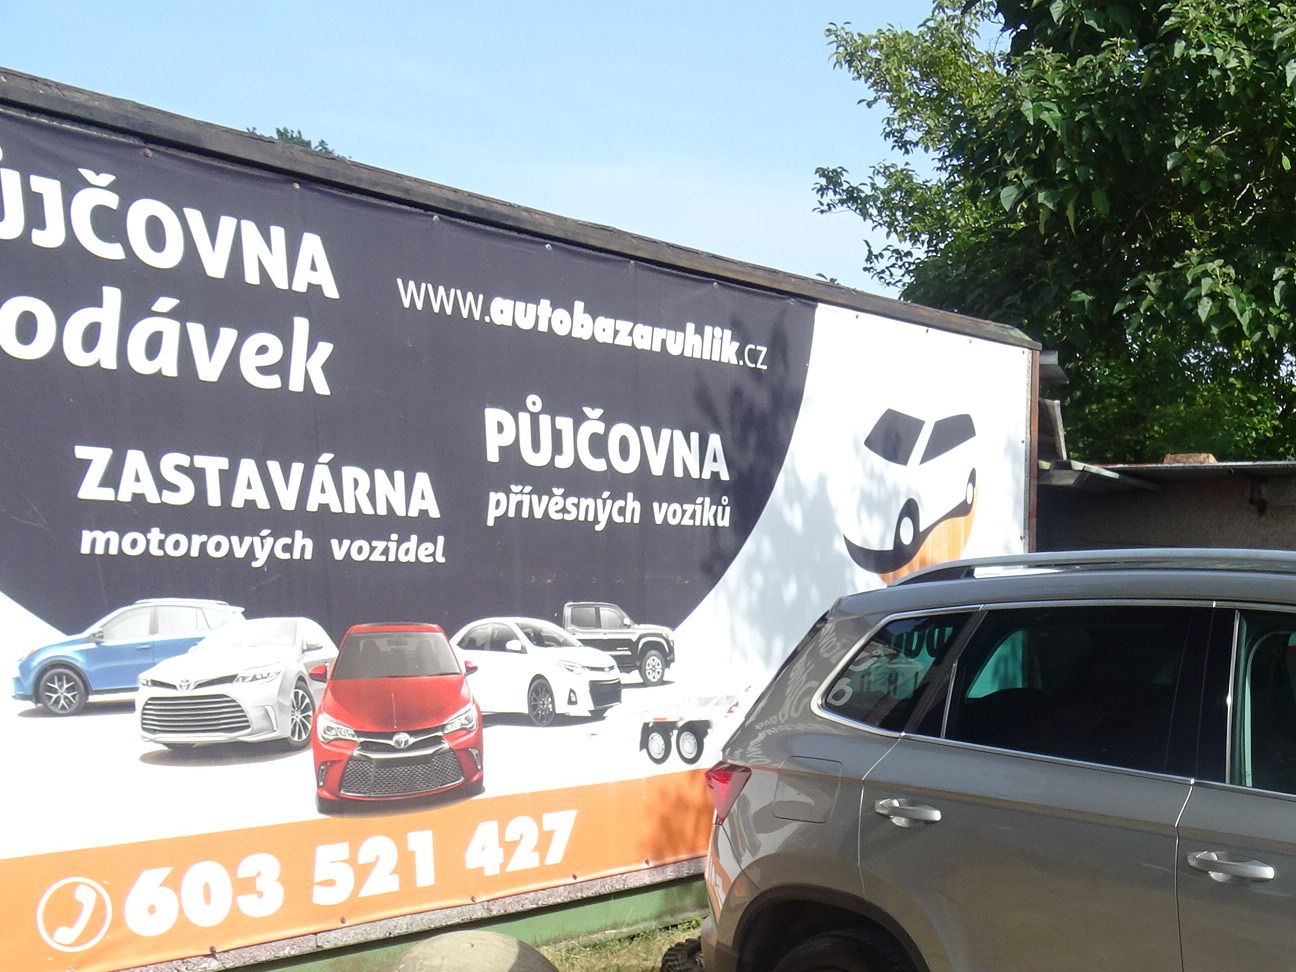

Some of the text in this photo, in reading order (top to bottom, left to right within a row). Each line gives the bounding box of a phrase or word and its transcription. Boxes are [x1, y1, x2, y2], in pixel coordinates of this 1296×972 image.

[0, 285, 332, 396] odávek
[396, 277, 769, 371] www.autobazaruhlik.cz
[484, 394, 731, 481] PŮJČOVNA
[73, 444, 442, 519] ZASTAVÁRNA
[486, 483, 731, 532] přívěsných vozíků
[79, 527, 446, 568] motorových vozidel
[123, 809, 578, 937] 603 521 427
